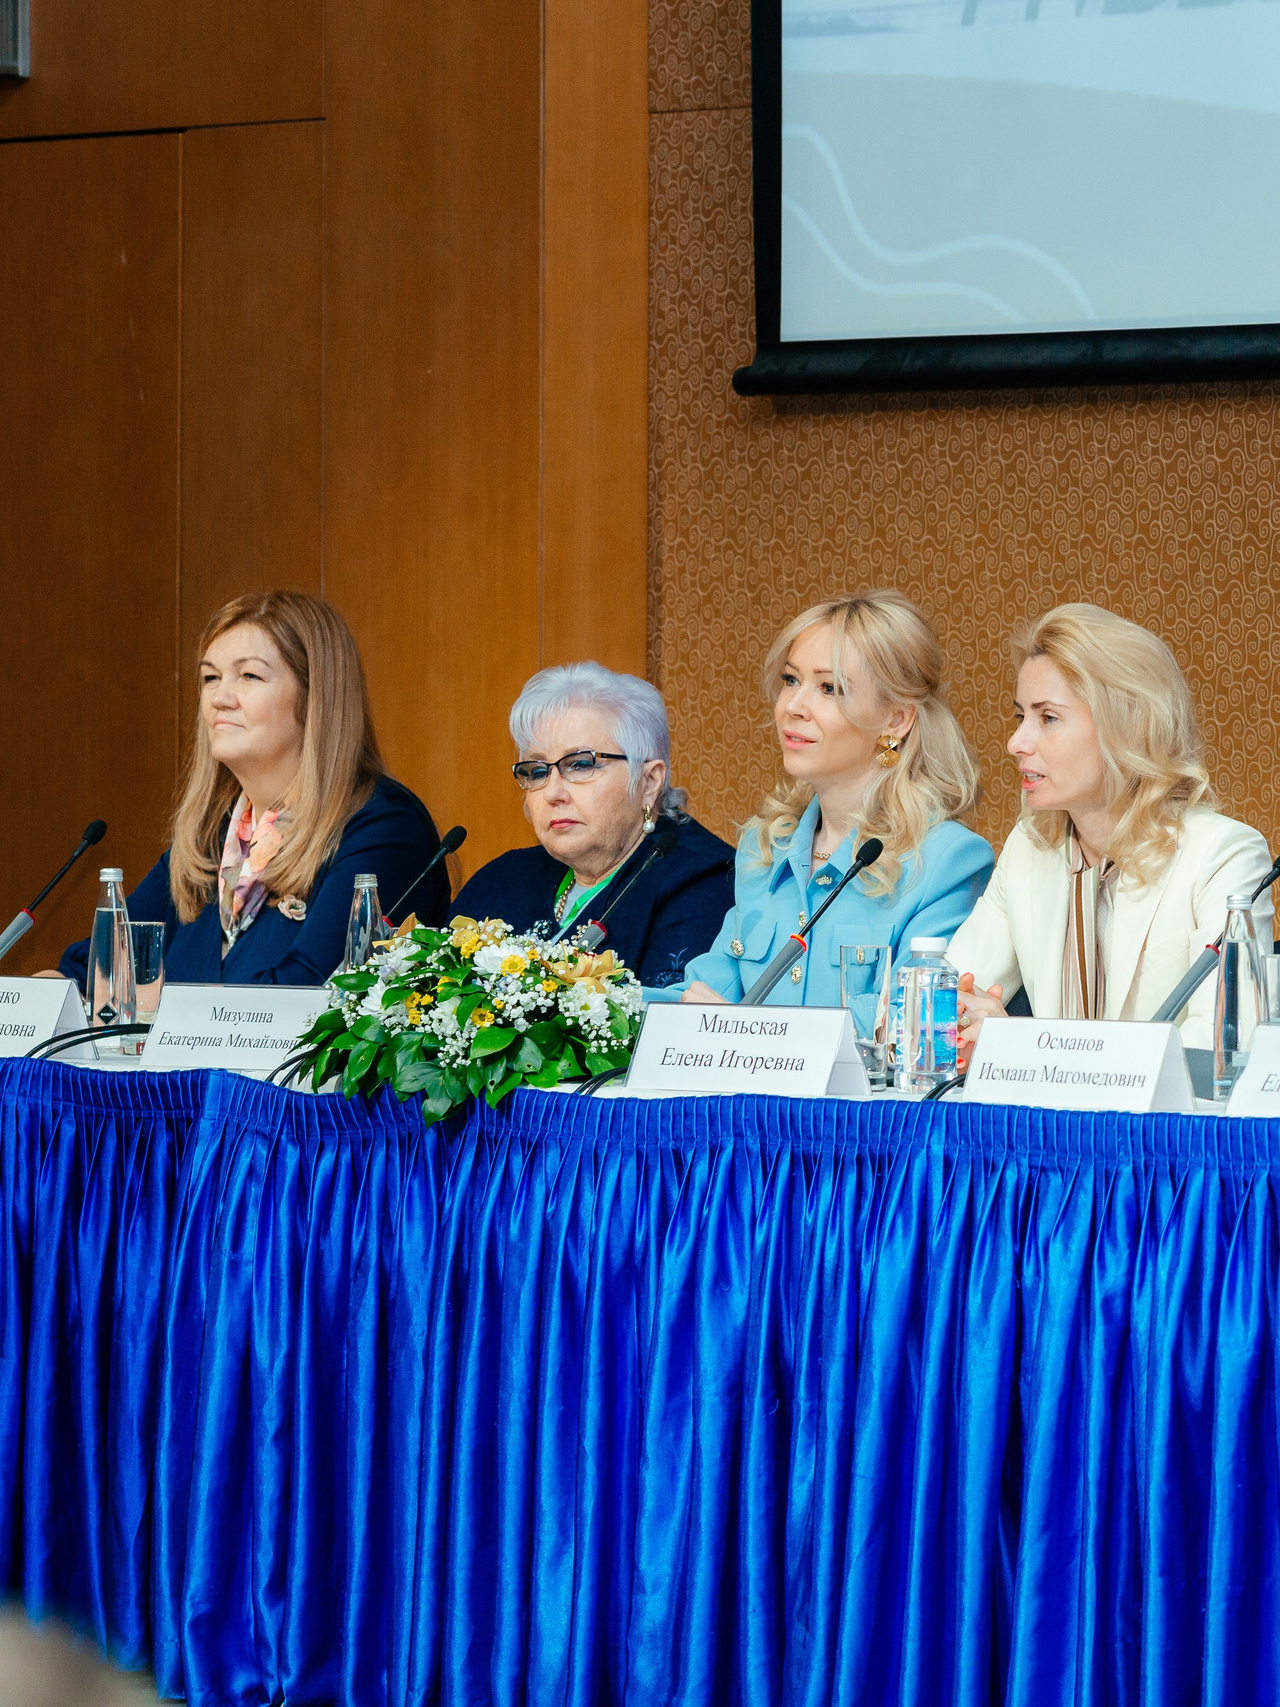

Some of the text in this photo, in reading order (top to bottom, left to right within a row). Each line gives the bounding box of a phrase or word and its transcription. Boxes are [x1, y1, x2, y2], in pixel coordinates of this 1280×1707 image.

[210, 1006, 274, 1025] Мизулина
[698, 1013, 789, 1036] Мильская
[158, 1031, 302, 1050] Екатерина Михайловн
[1037, 1031, 1105, 1052] Османов
[659, 1047, 805, 1075] Елена Игоревна
[978, 1062, 1147, 1088] Исмаил Магомедович
